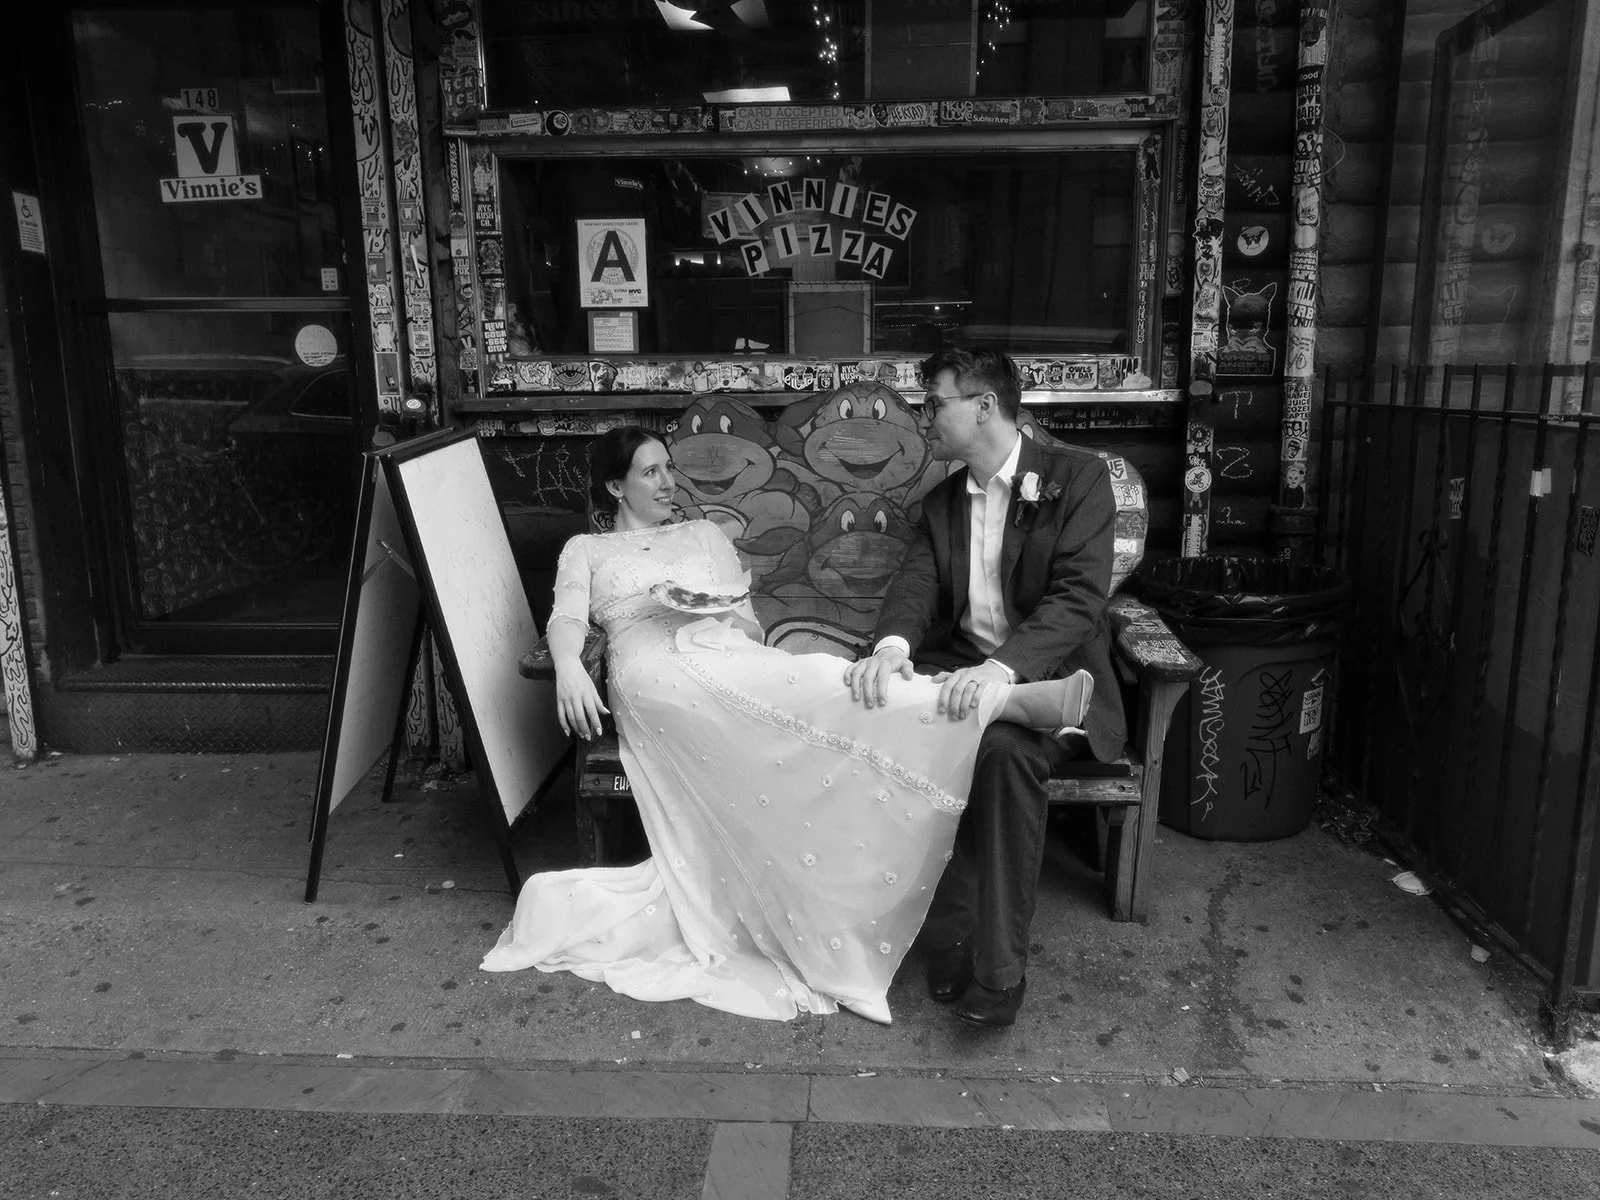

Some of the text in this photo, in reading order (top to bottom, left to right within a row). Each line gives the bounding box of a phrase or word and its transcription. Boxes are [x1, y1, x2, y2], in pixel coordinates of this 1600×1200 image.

[183, 89, 217, 107] 148
[738, 106, 840, 118] CARD ACCEPTED
[737, 118, 845, 130] CASH PREFERRED
[176, 122, 228, 174] V
[163, 178, 259, 200] Vinnie's
[710, 180, 914, 241] VINNIES
[590, 230, 636, 282] A
[746, 225, 886, 277] PIZZA
[1065, 372, 1095, 380] BY DAY
